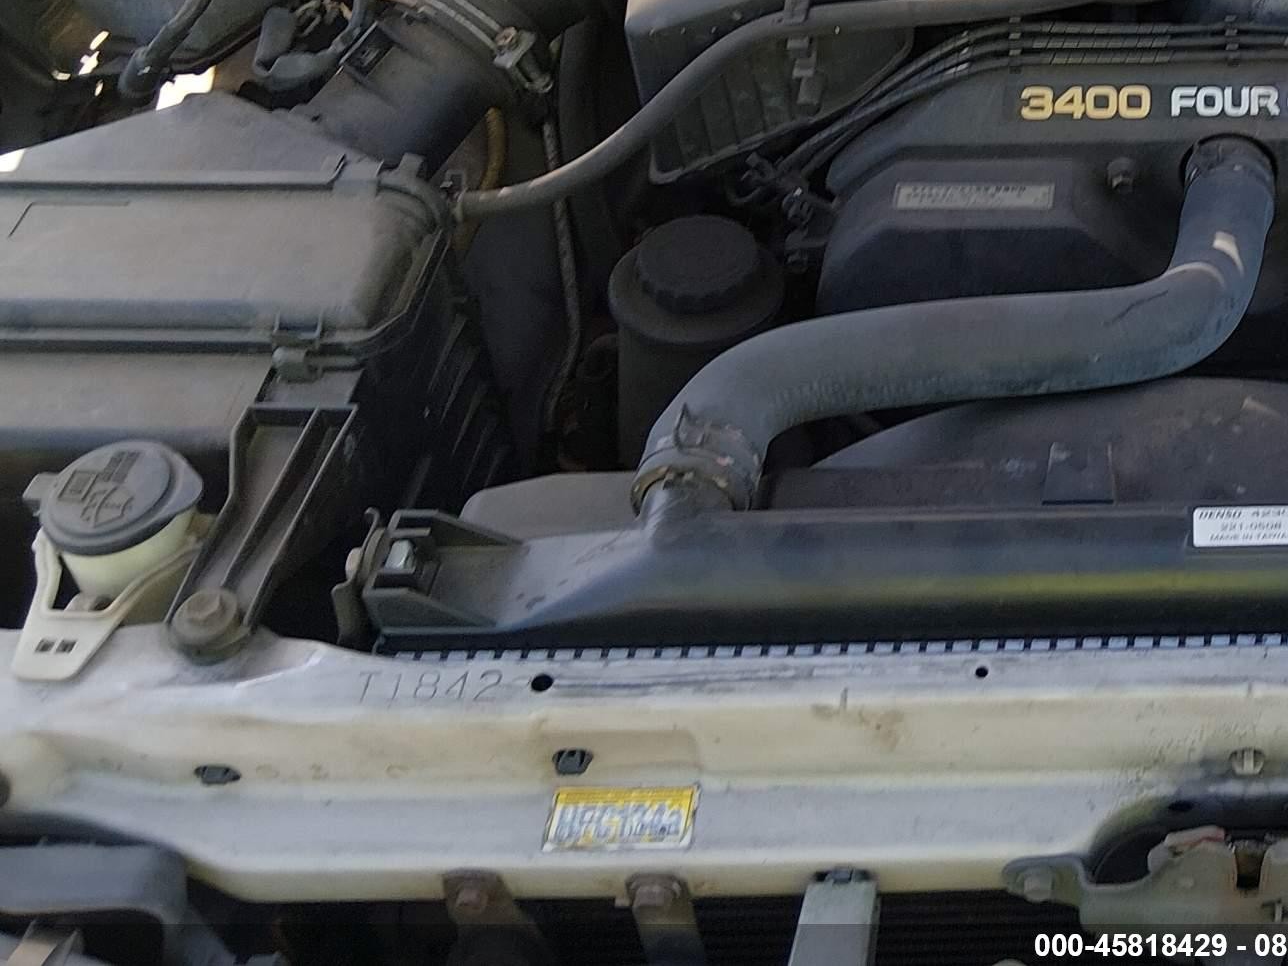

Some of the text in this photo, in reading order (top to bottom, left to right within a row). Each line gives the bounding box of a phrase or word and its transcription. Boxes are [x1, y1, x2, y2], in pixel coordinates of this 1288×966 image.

[1020, 85, 1152, 120] 3400
[1170, 84, 1281, 118] FOUR
[1198, 509, 1243, 521] DENSO
[1209, 533, 1241, 542] MADE
[1242, 532, 1254, 541] IN
